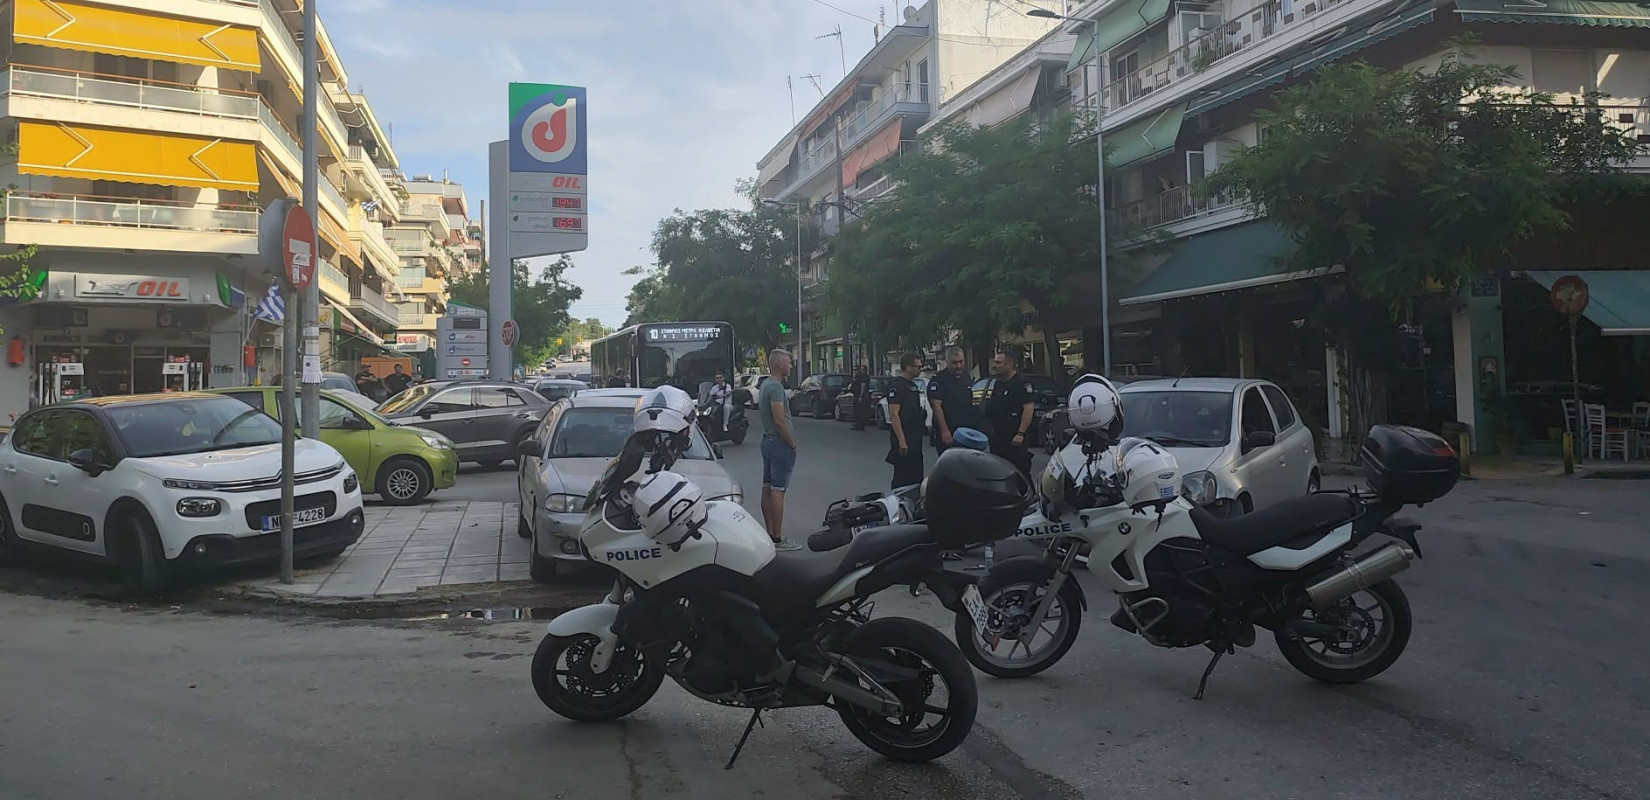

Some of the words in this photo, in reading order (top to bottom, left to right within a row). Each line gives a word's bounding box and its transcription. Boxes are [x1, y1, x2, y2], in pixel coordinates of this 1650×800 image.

[552, 176, 580, 189] OIL
[136, 280, 182, 297] OIL
[649, 328, 659, 339] 10
[1014, 523, 1072, 537] POLICE
[606, 547, 662, 562] POLICE
